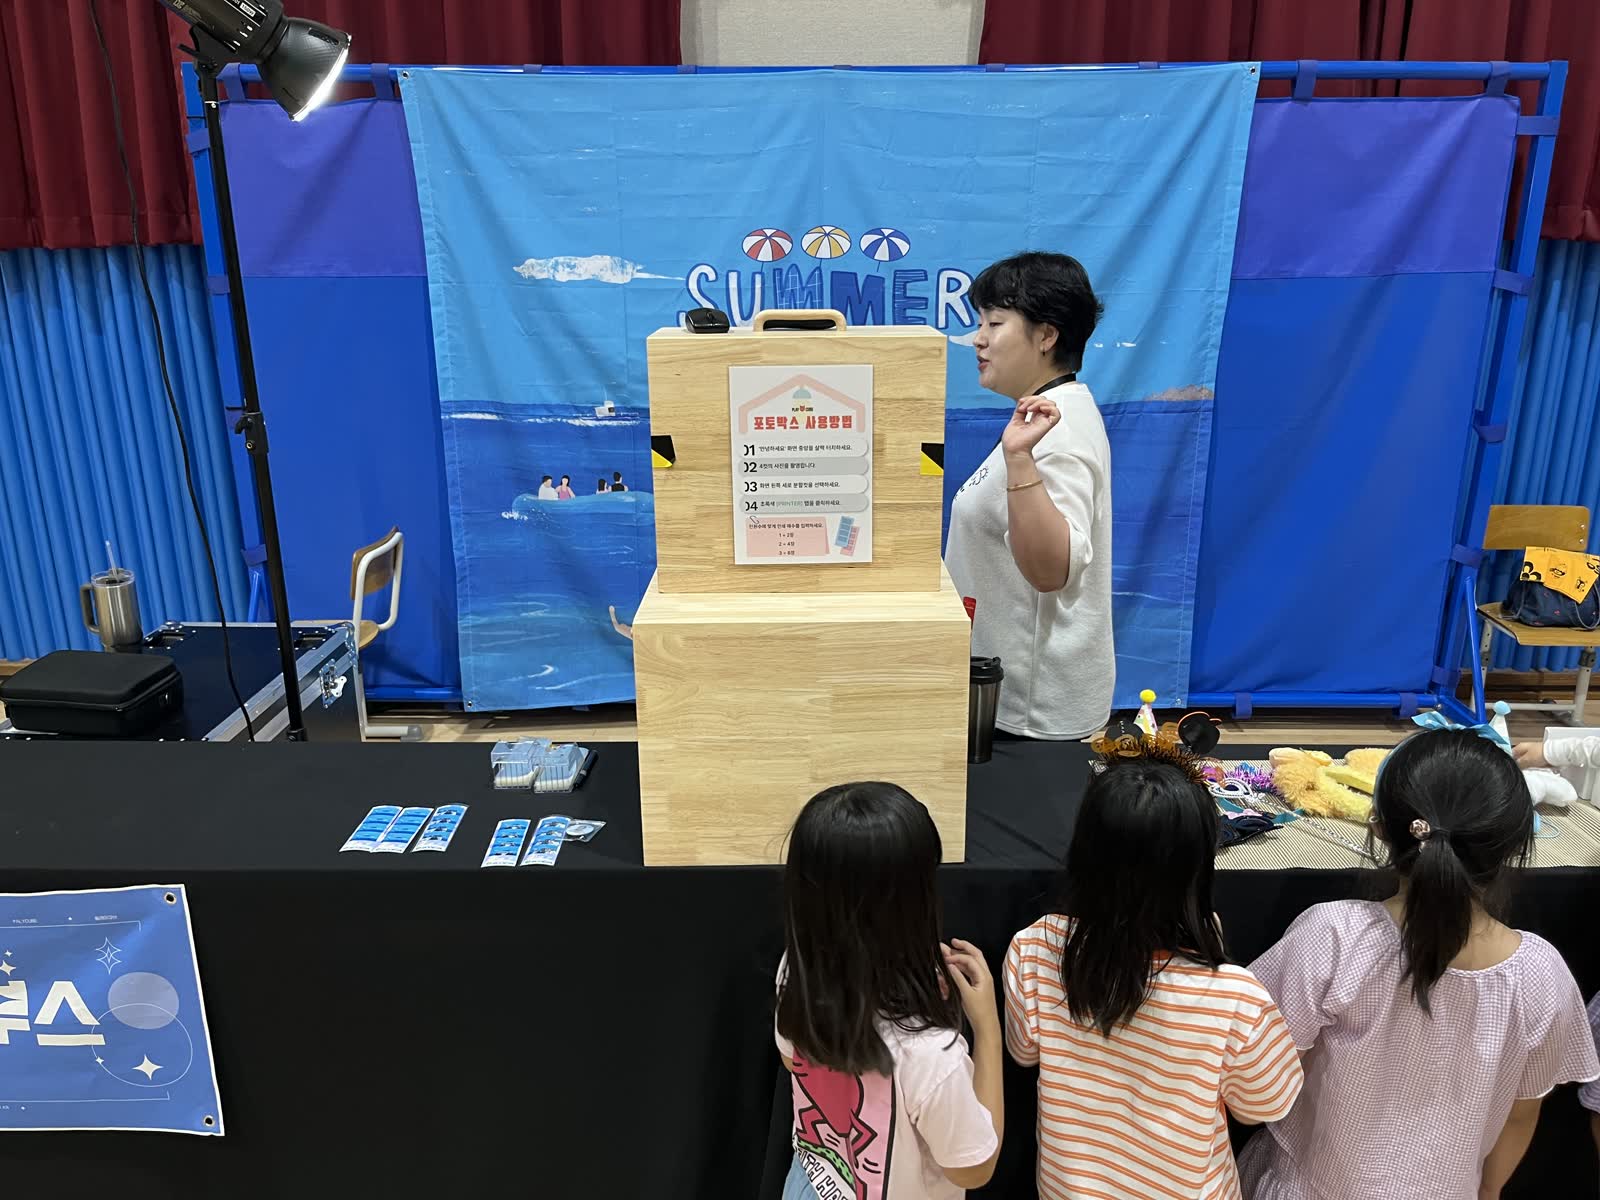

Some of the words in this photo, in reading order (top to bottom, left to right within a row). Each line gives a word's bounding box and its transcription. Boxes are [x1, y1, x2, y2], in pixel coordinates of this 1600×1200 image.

[680, 263, 976, 329] SUMMER
[753, 416, 799, 430] 포토박스
[805, 415, 852, 429] 사용방법
[799, 1149, 826, 1183] ITH
